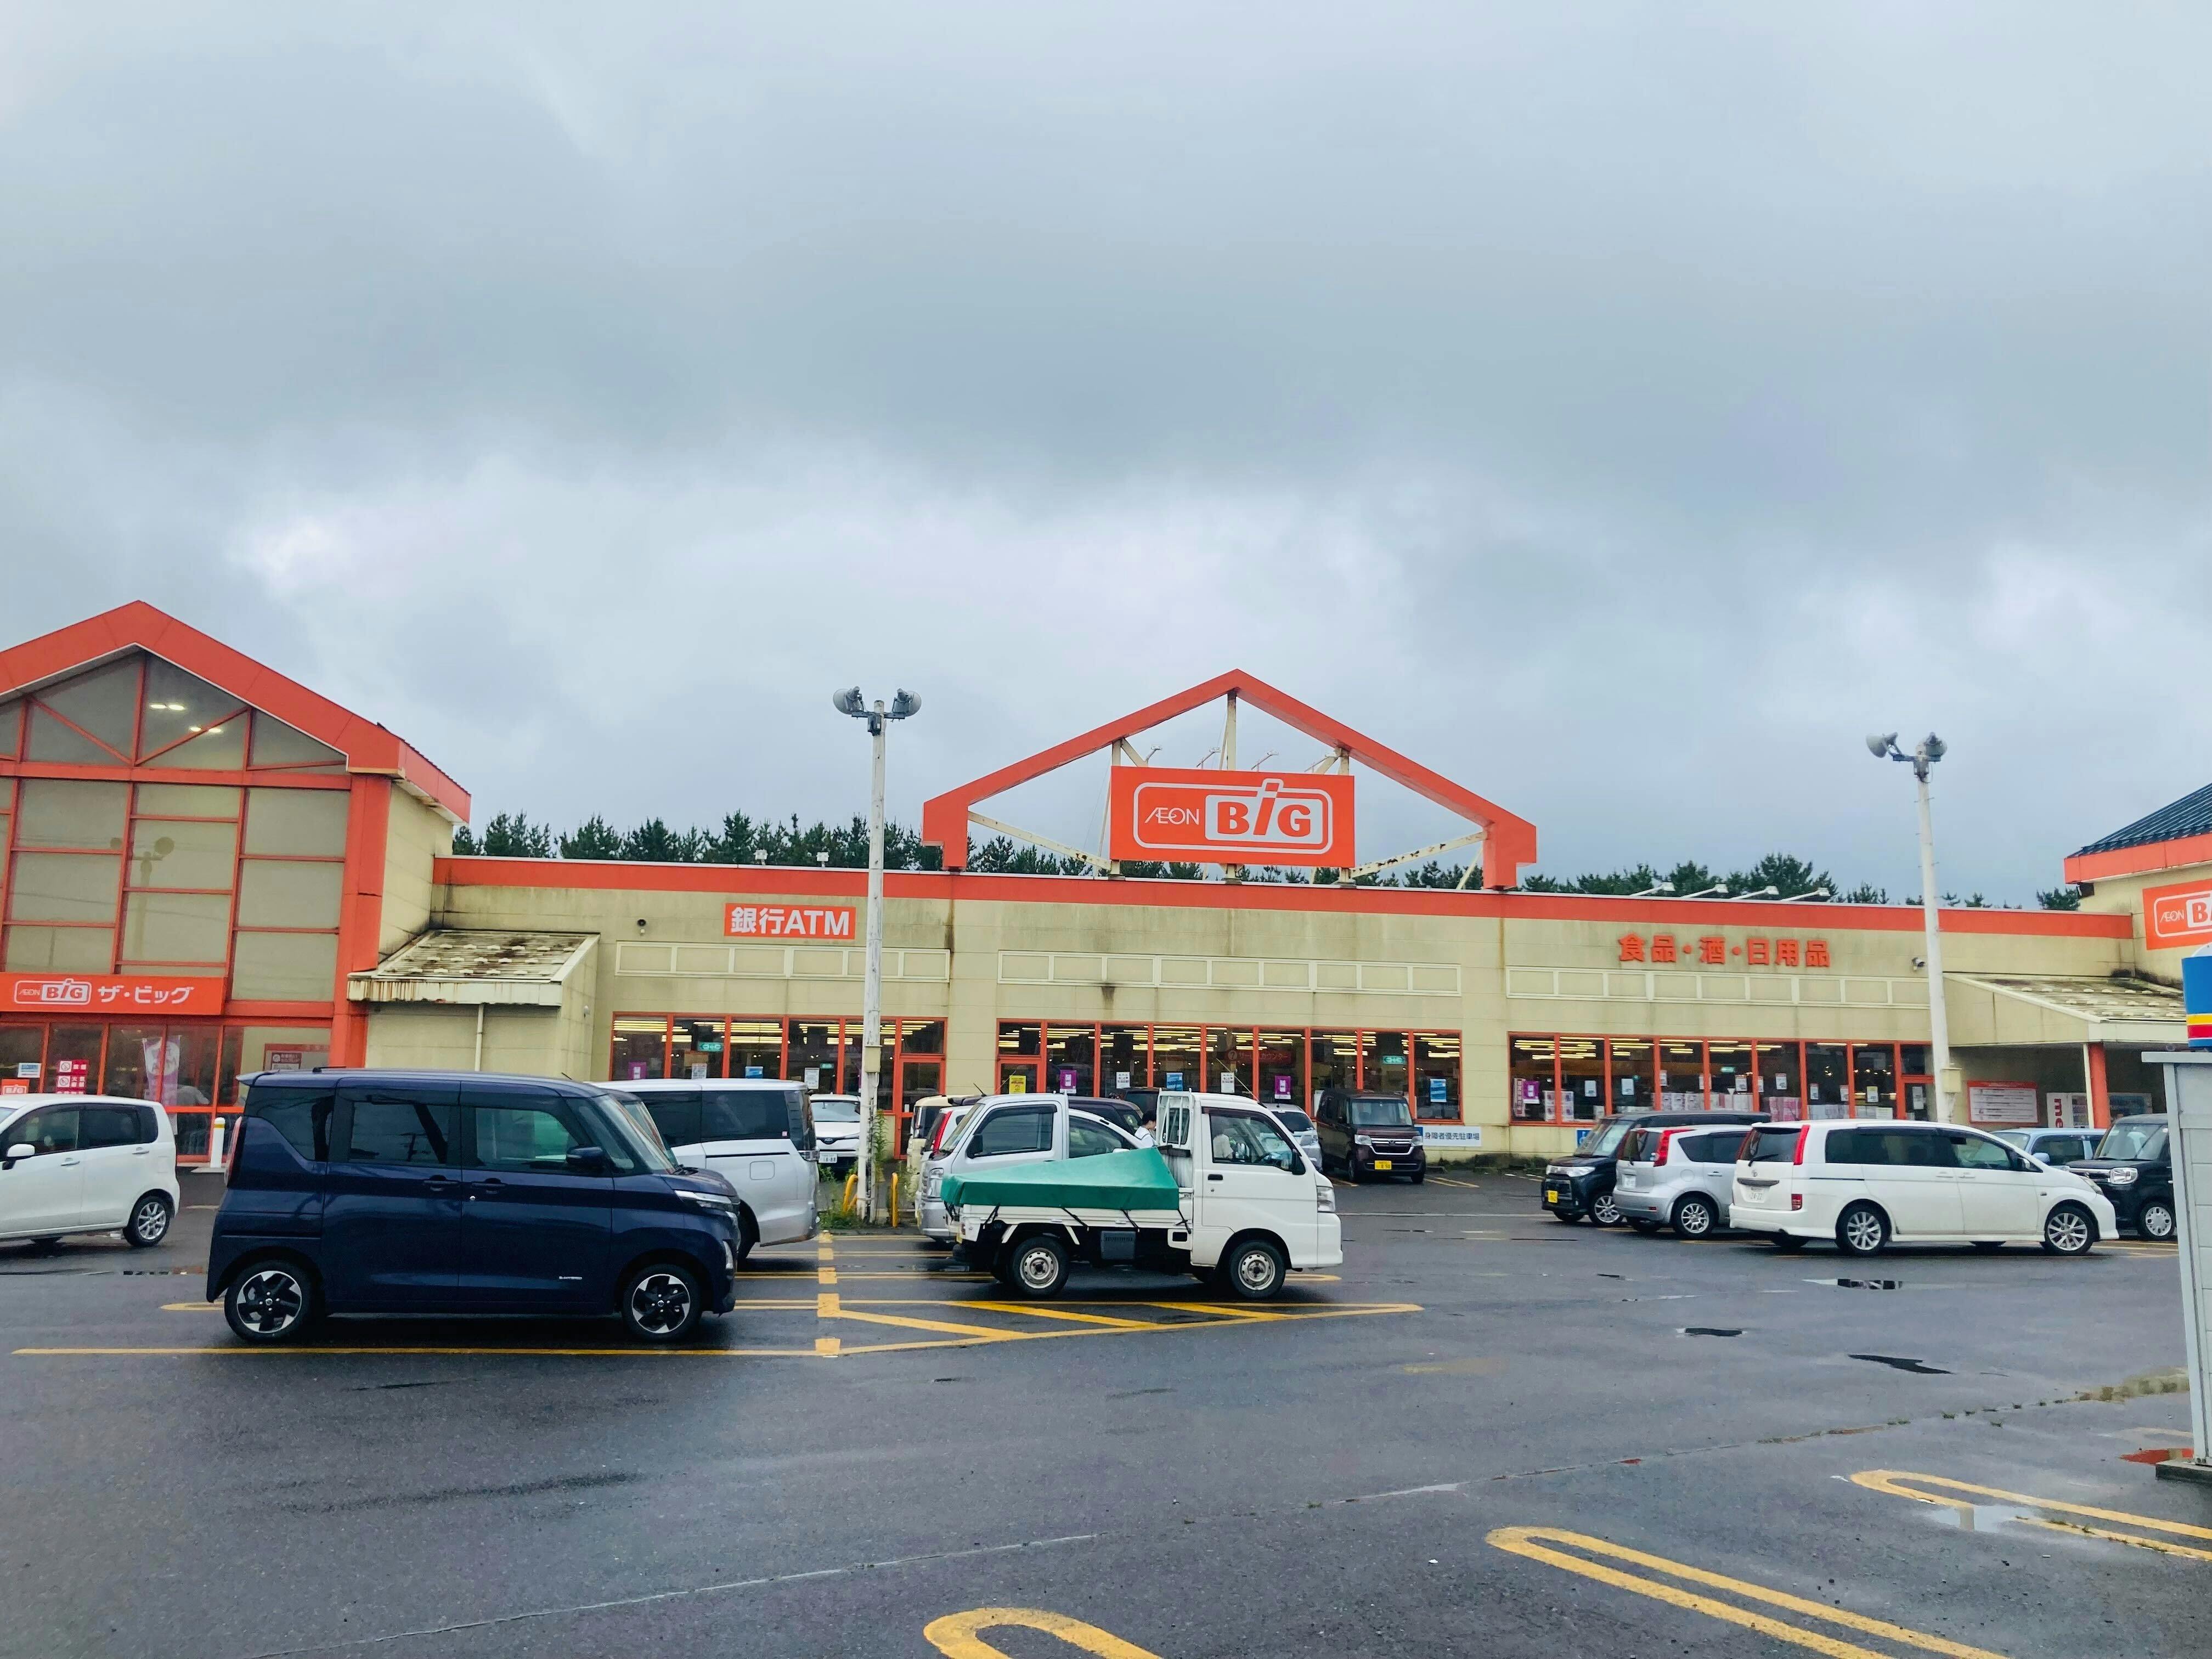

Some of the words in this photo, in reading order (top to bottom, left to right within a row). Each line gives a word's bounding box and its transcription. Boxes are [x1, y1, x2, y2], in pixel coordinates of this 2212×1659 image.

[730, 907, 850, 936] 銀行ATM
[98, 985, 195, 1004] ザ・ビッグ
